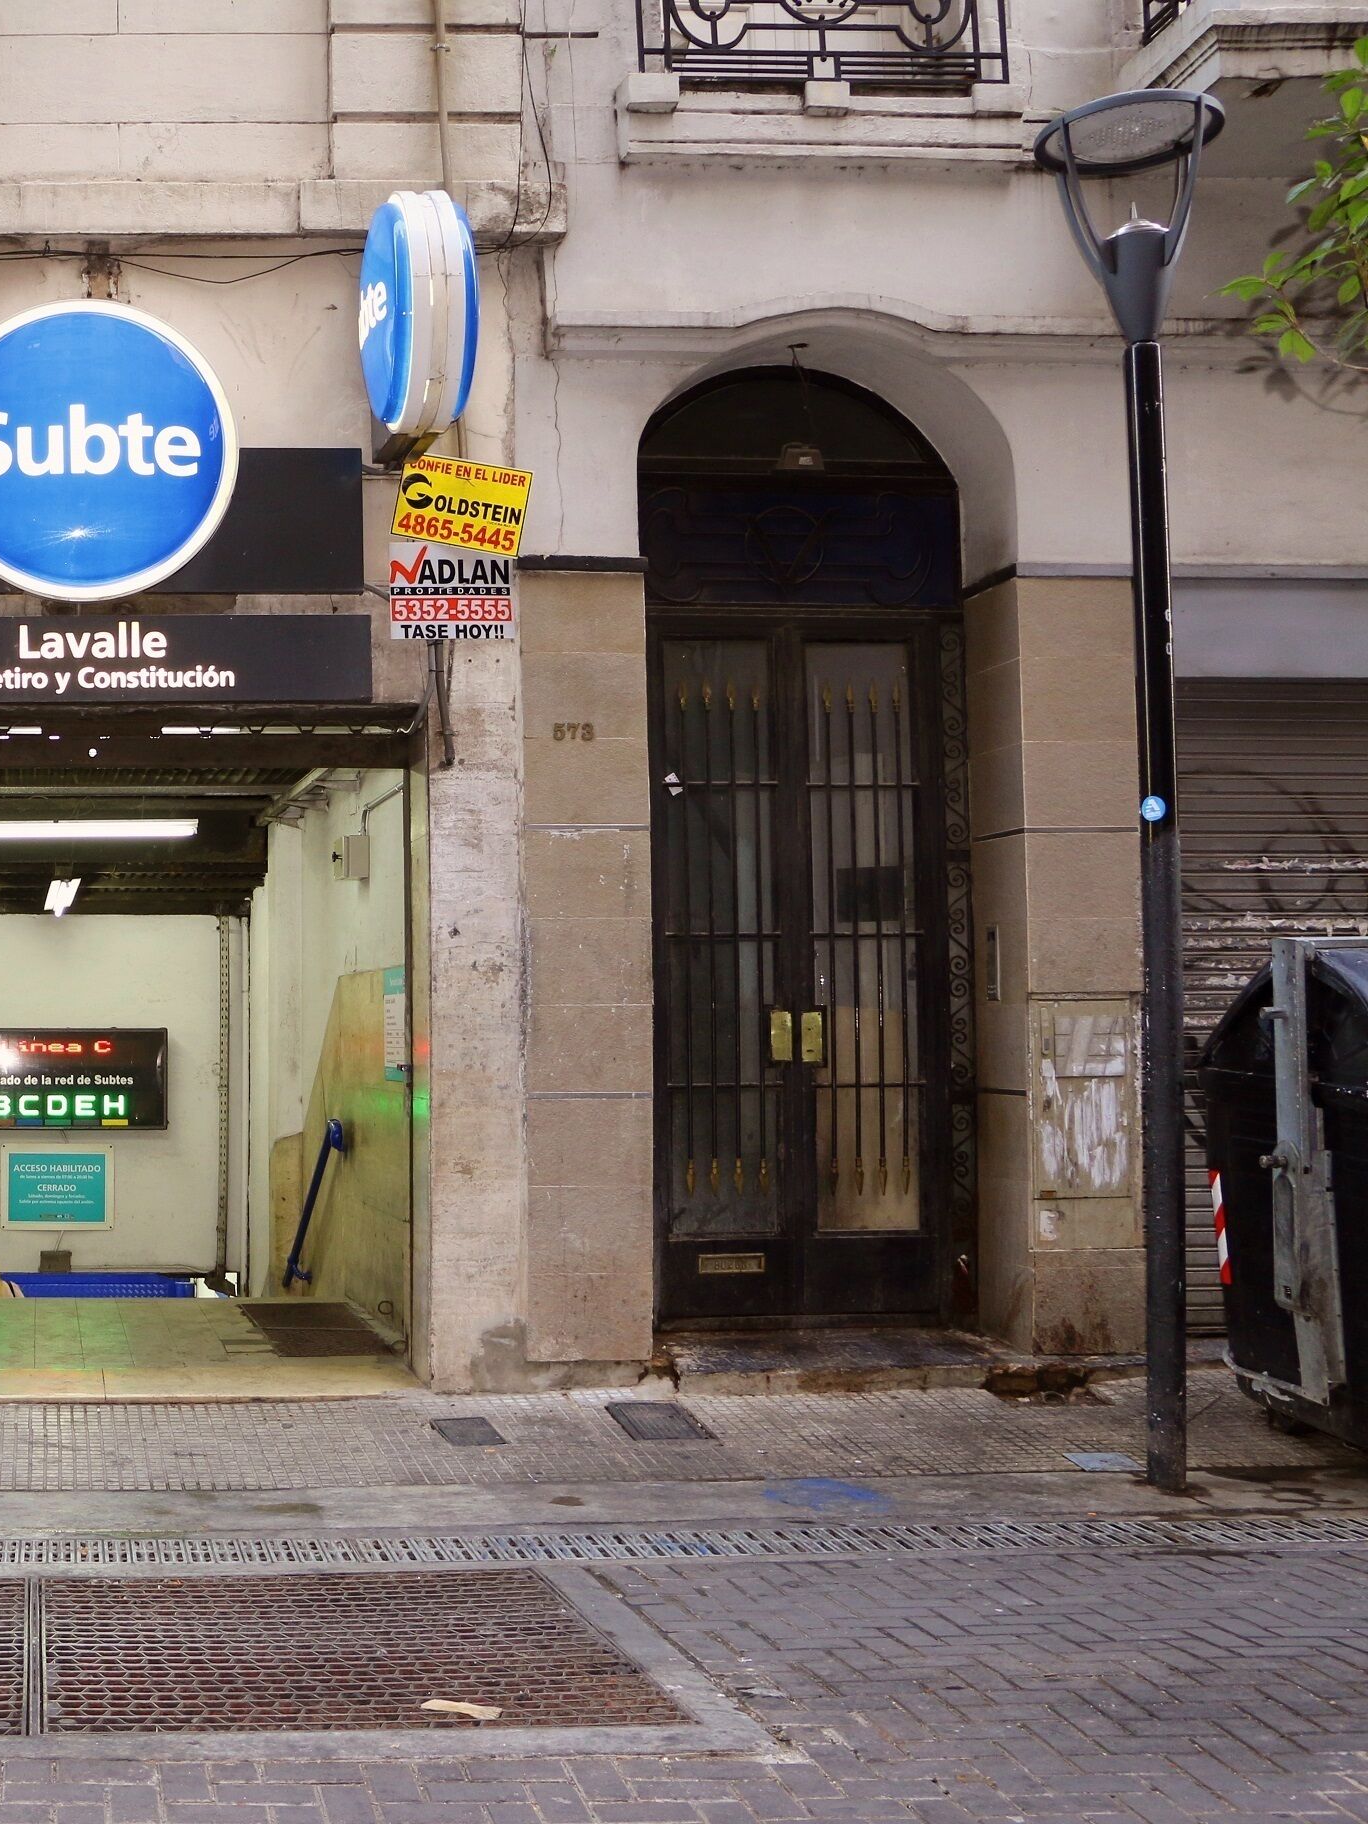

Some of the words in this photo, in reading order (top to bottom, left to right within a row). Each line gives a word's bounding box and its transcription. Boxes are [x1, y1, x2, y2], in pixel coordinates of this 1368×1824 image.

[358, 281, 387, 350] bte
[456, 467, 472, 478] EN
[474, 469, 489, 481] EL
[491, 471, 526, 487] LIDER
[402, 473, 522, 525] GOLDSTEIN
[397, 512, 516, 551] 4865-5445
[389, 545, 510, 585] NADLAN
[394, 600, 510, 620] 5352-5555
[18, 621, 168, 660] Lavalle
[401, 625, 448, 639] TASE
[455, 625, 504, 639] HOY!!
[54, 671, 71, 694] y
[77, 665, 236, 689] Constitución
[94, 1040, 112, 1053] C
[24, 1074, 38, 1086] de
[41, 1074, 52, 1086] la
[55, 1074, 74, 1086] red
[77, 1074, 91, 1086] de
[94, 1074, 134, 1086] Subtes
[13, 1164, 48, 1173] ACCESO
[49, 1164, 101, 1173] HABILITADO
[37, 1184, 77, 1192] CERRADO
